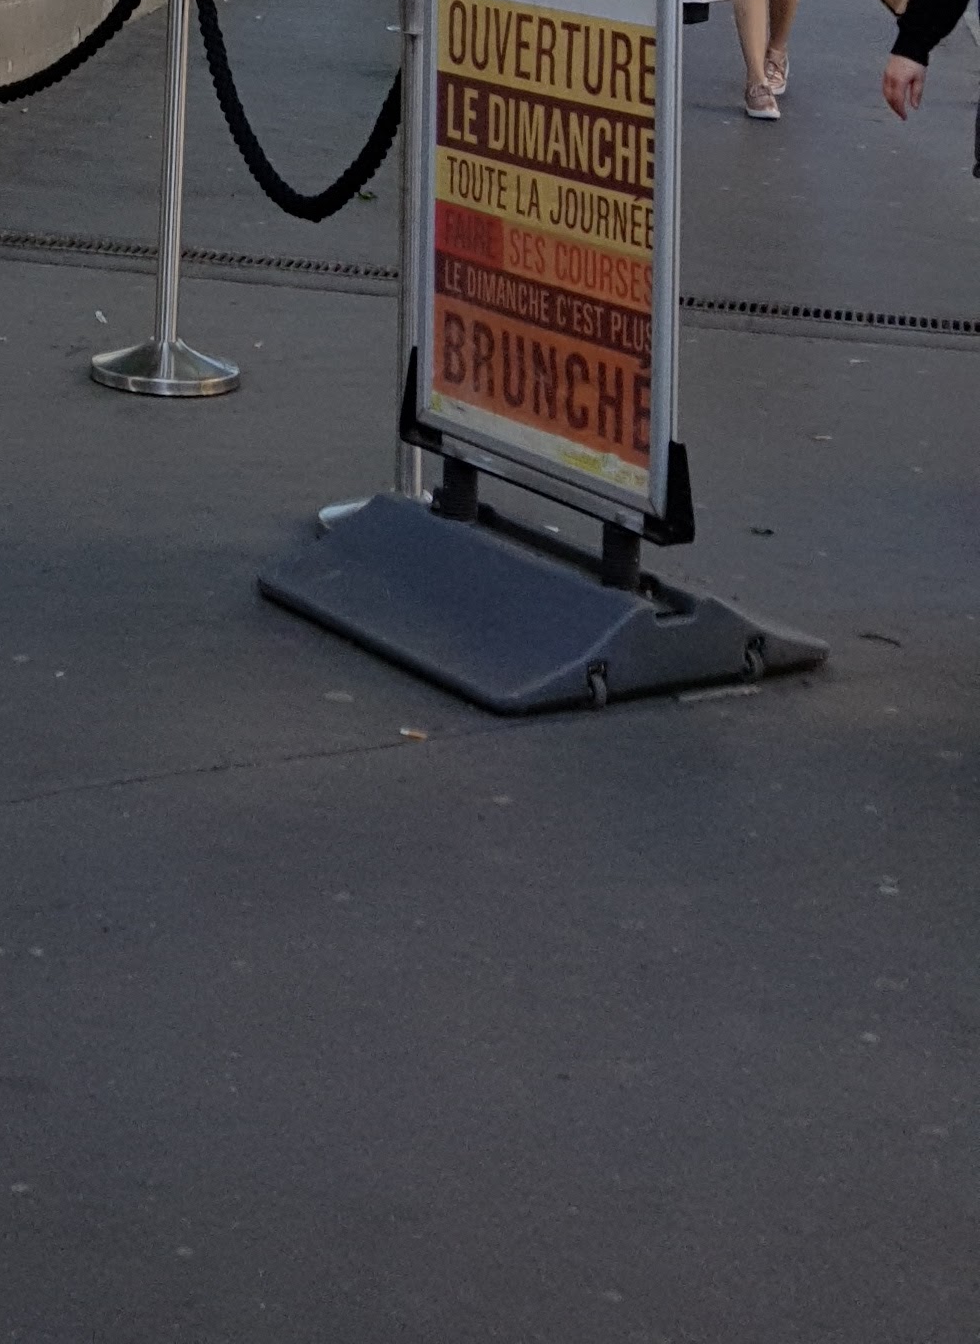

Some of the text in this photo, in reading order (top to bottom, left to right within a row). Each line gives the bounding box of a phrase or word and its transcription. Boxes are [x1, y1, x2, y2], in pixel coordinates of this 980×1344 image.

[448, 0, 656, 107] OUVERTURE
[447, 83, 655, 189] LE DIMANCHE
[447, 156, 654, 251] TOUTE LA JOURNÉE
[444, 210, 653, 308] FAIRE SES COURSES
[444, 259, 463, 295] LE
[467, 268, 551, 323] DIMANCHE
[556, 296, 605, 339] C'EST
